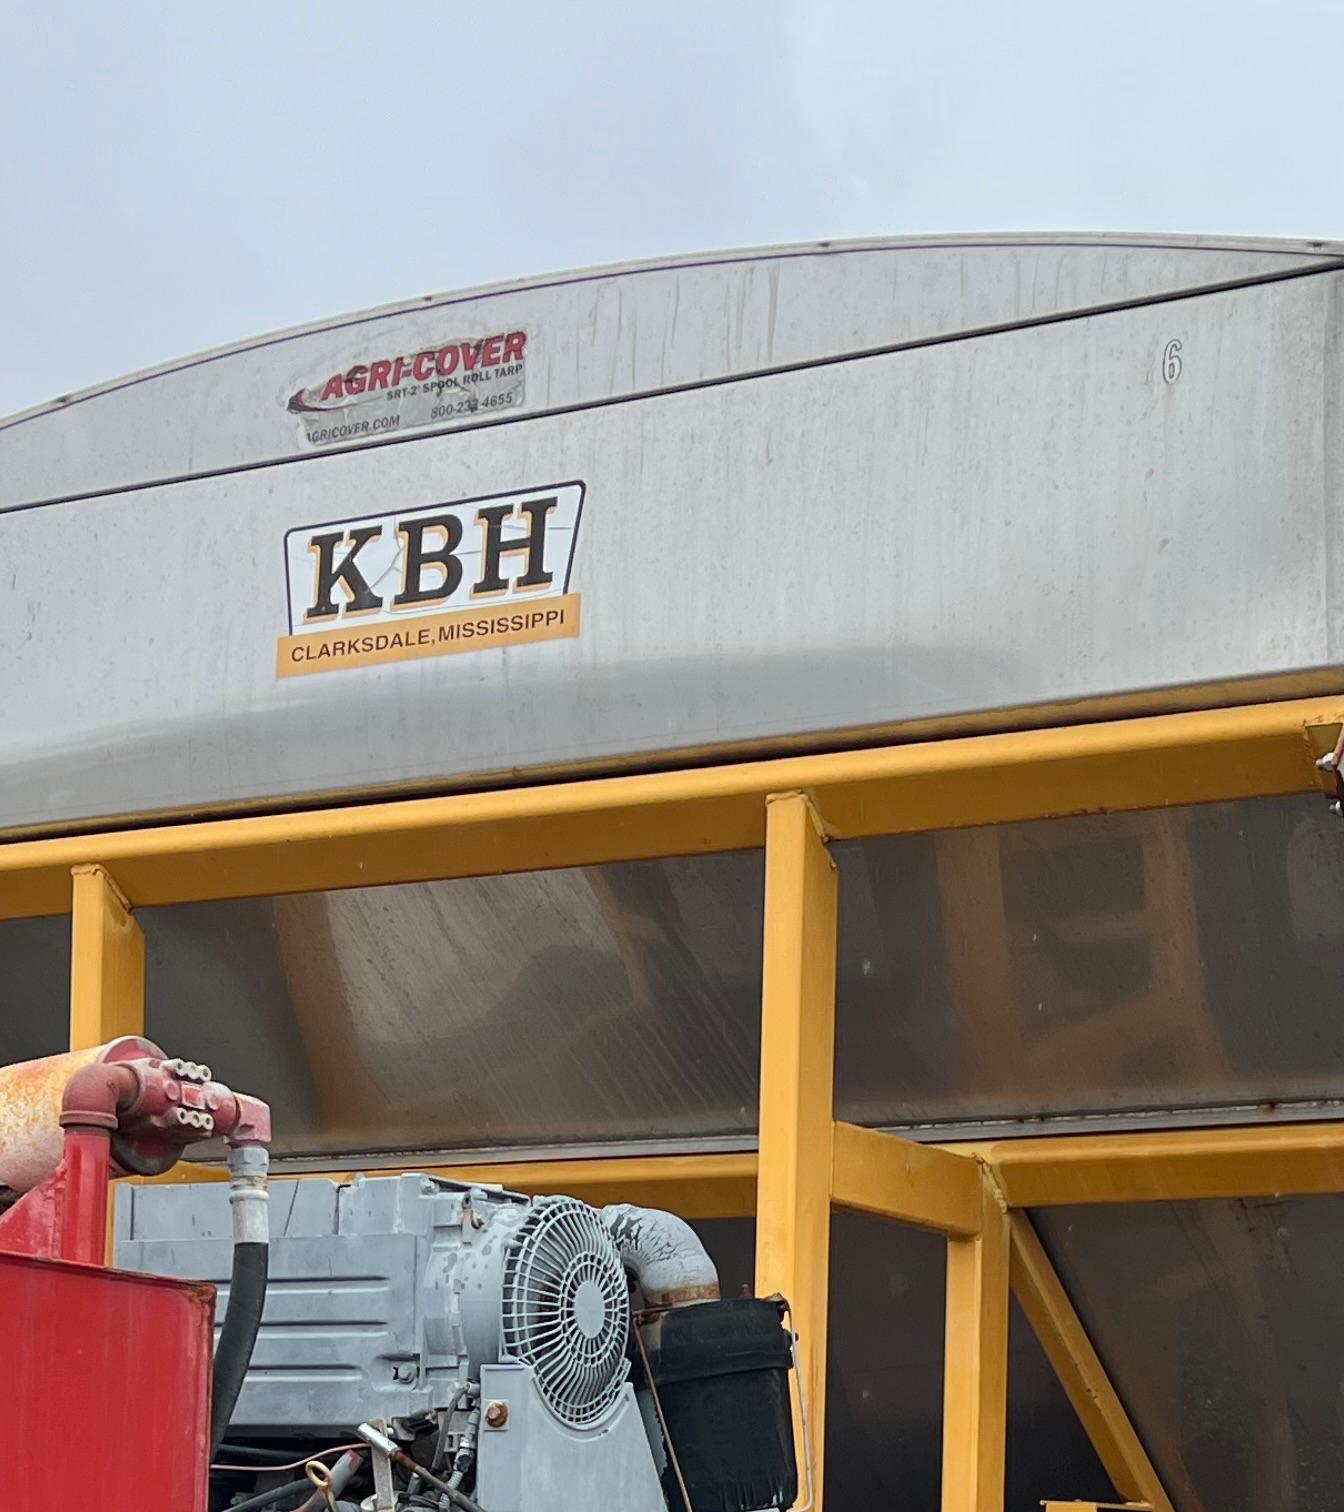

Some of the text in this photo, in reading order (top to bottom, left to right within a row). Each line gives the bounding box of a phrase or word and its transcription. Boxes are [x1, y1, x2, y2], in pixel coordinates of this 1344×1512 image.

[321, 331, 527, 401] AGRI-COVER
[422, 378, 458, 394] SPOOL
[463, 370, 492, 385] ROLL
[494, 363, 523, 378] TARP
[1162, 338, 1184, 385] 6
[304, 496, 558, 623] KBH
